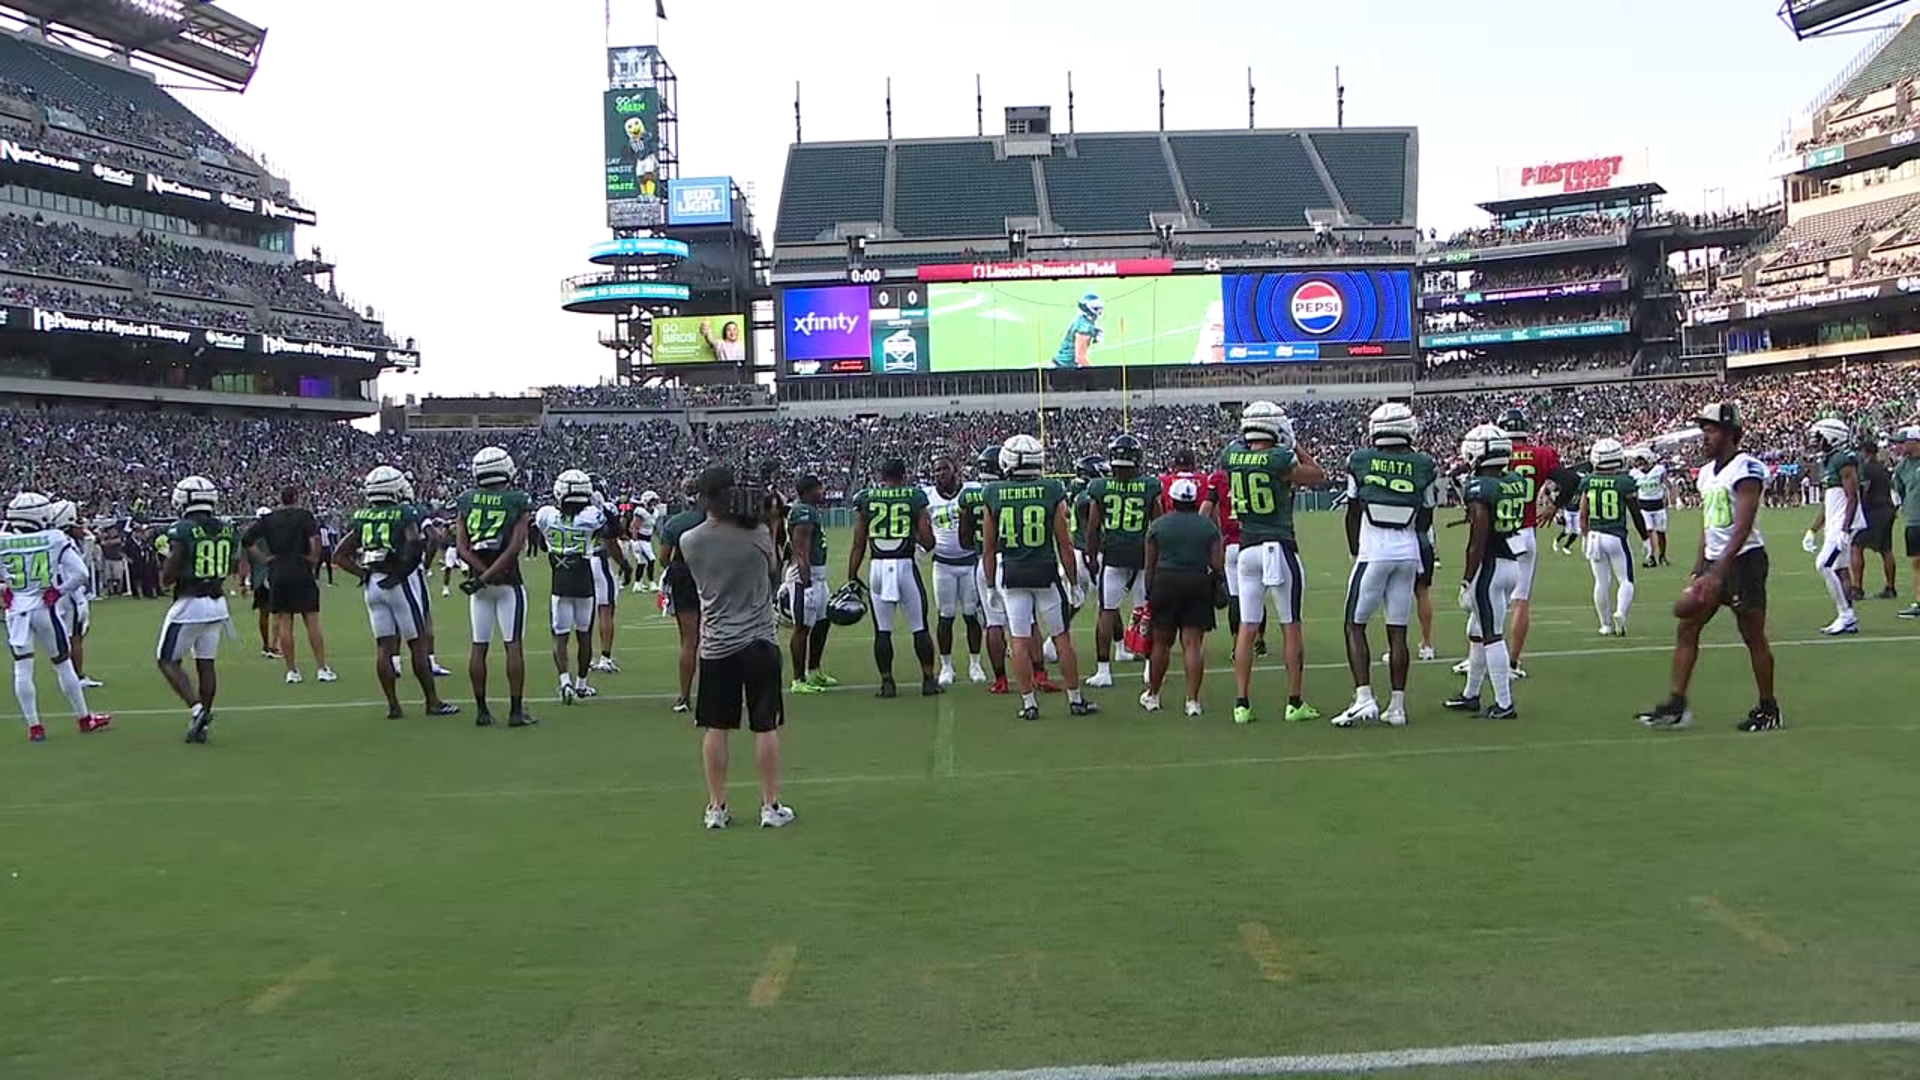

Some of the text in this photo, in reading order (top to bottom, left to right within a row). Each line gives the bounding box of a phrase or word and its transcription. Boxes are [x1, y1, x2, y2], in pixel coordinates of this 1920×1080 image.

[683, 189, 715, 201] BUD
[678, 201, 722, 213] LIGHT
[851, 269, 880, 283] 0:00
[986, 261, 1117, 279] Lincoln Financial Field
[879, 290, 917, 306] 0 0
[1295, 302, 1339, 313] PEPSI
[91, 319, 104, 332] of
[105, 320, 149, 337] Physical
[149, 325, 191, 343] Therapy
[662, 323, 679, 333] GO
[793, 311, 859, 337] xfinity
[1229, 452, 1269, 466] HARRIS
[1371, 458, 1414, 476] NGATA
[998, 485, 1045, 500] HEBERT
[1106, 480, 1146, 493] MILTON
[1228, 471, 1276, 518] 46
[1103, 494, 1144, 532] 36
[1587, 489, 1619, 520] 18
[466, 508, 506, 542] 47
[868, 502, 912, 538] 26
[998, 505, 1047, 549] 48
[194, 539, 230, 578] 80
[1, 551, 50, 589] 34
